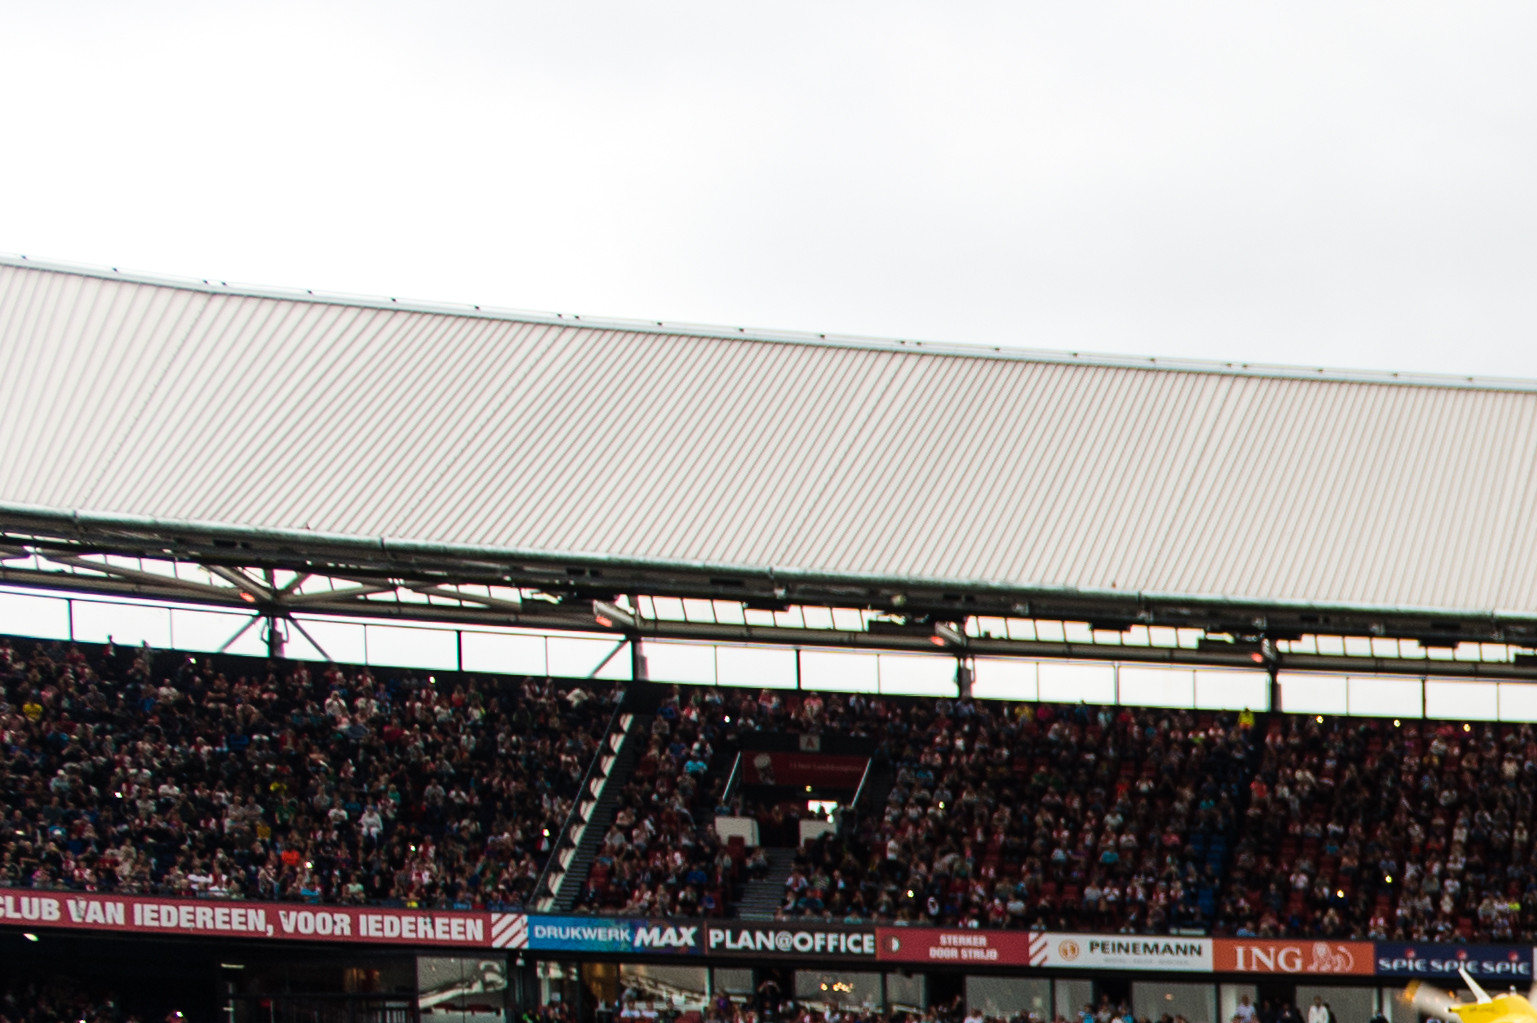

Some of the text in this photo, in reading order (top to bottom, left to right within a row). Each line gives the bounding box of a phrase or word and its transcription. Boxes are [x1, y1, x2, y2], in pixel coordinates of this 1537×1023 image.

[66, 898, 125, 925] VAN
[134, 903, 274, 937] IEDEREEN,
[279, 911, 351, 935] VOOR
[359, 914, 484, 942] IEDEREEN
[534, 925, 698, 948] DRUKWERK MAX
[709, 929, 875, 954] PLAN@OFFICE
[1089, 940, 1203, 957] PEINEMANN
[1235, 946, 1302, 972] ING
